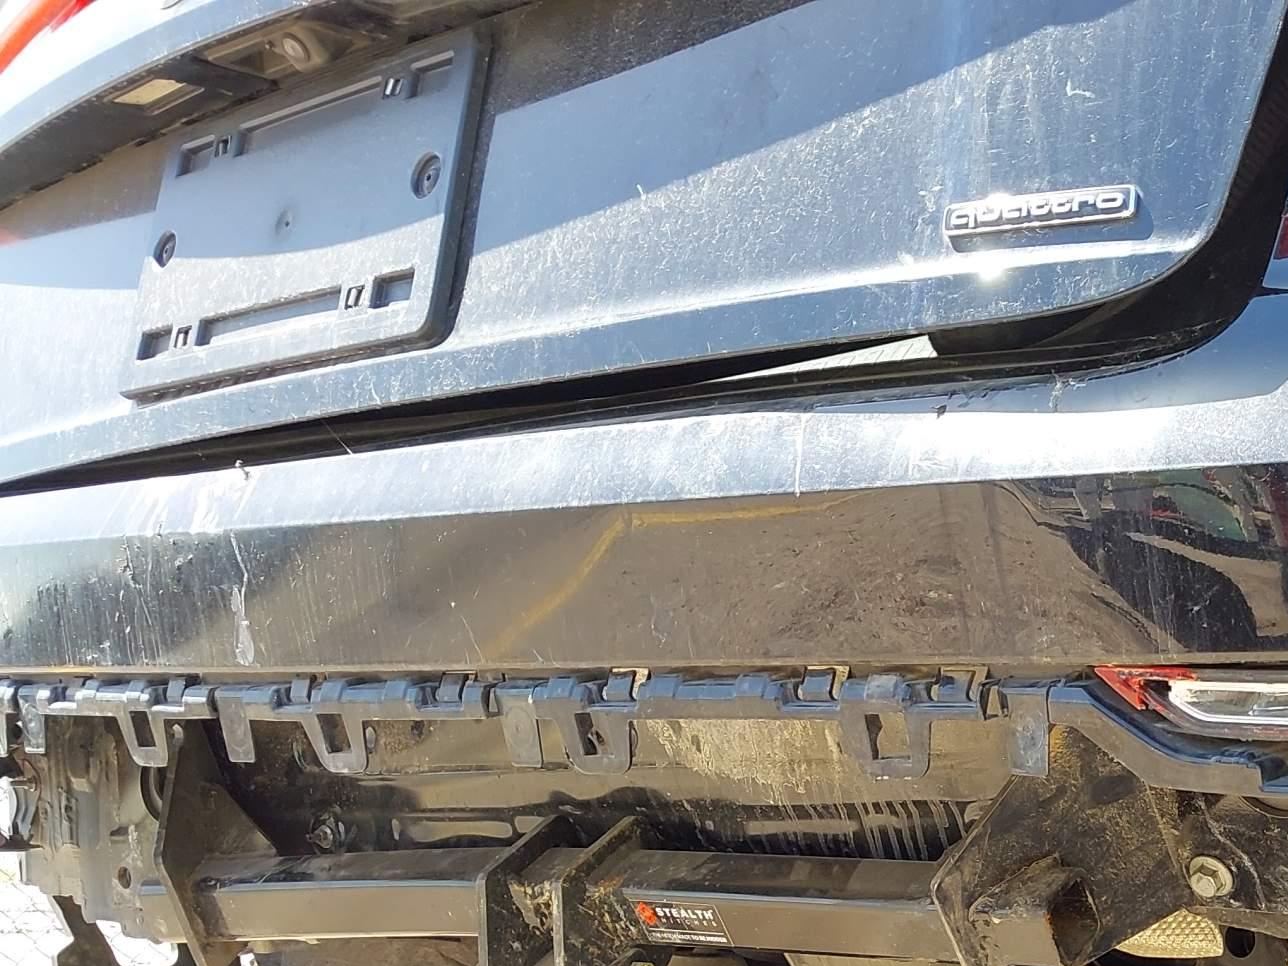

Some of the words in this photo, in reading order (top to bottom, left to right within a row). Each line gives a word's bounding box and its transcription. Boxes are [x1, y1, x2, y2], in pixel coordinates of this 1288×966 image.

[950, 191, 1125, 228] quattro
[655, 907, 714, 920] STEALTH
[661, 918, 718, 927] HITCHES
